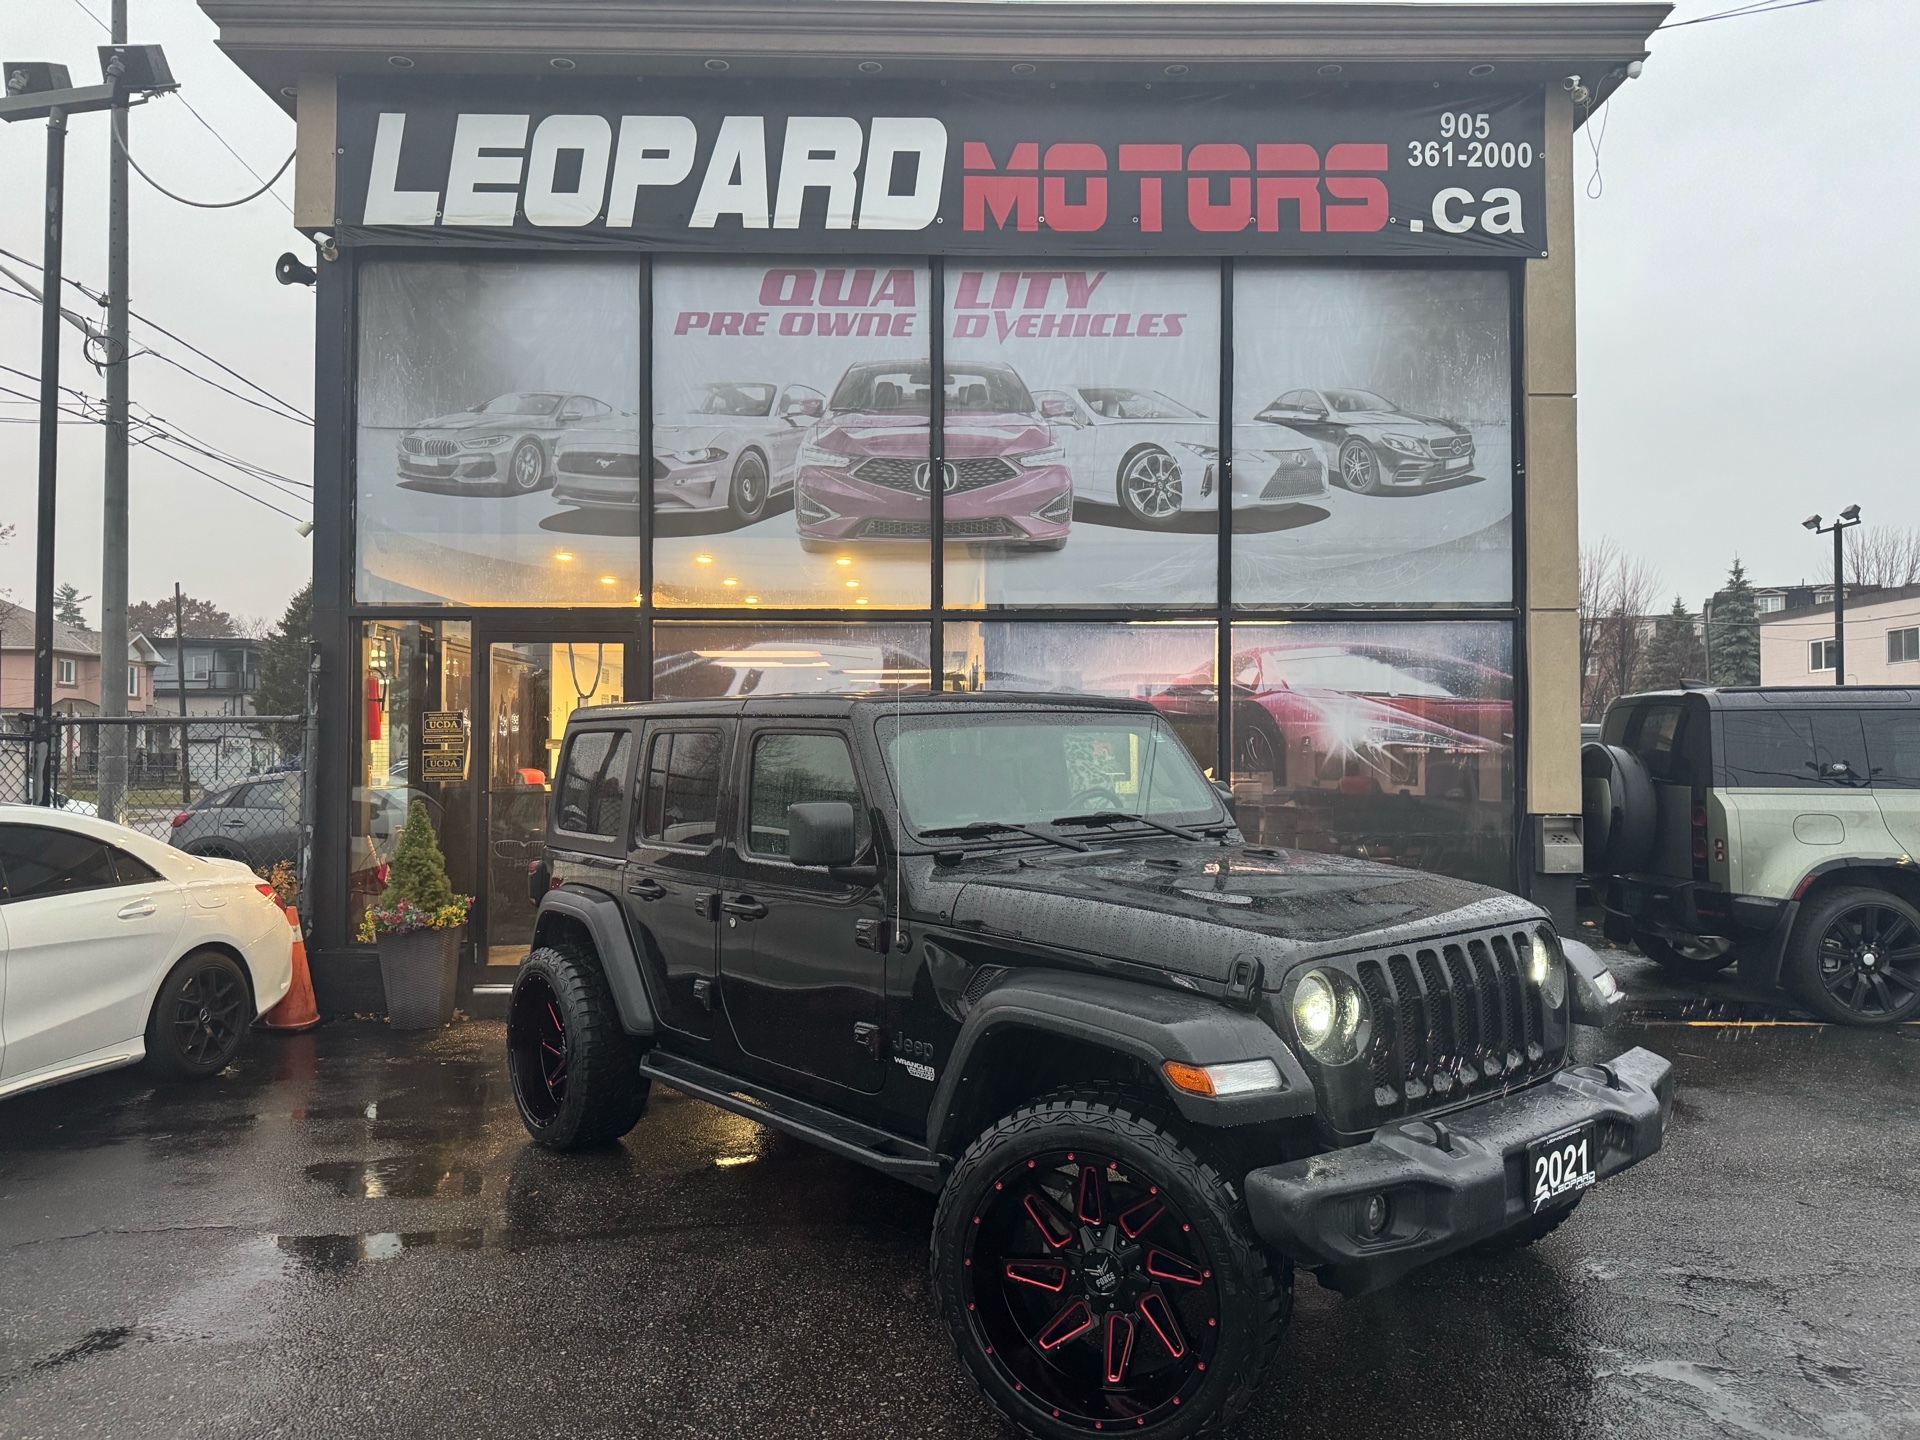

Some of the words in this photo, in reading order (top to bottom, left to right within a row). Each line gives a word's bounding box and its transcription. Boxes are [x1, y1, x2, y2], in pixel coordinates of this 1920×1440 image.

[1440, 112, 1490, 139] 905
[1408, 141, 1532, 168] 361-2000
[363, 113, 948, 230] LEOPARD
[963, 142, 1390, 232] MOTORS
[1410, 187, 1525, 234] .ca
[674, 312, 769, 335] PRE
[429, 720, 458, 729] UCDA
[430, 760, 457, 768] UCDA
[893, 1031, 933, 1063] Jeep
[894, 1056, 934, 1073] WRANGLER
[1535, 1139, 1587, 1196] 2021
[1551, 1170, 1595, 1196] LEOPARD
[1096, 1271, 1116, 1288] FORCE
